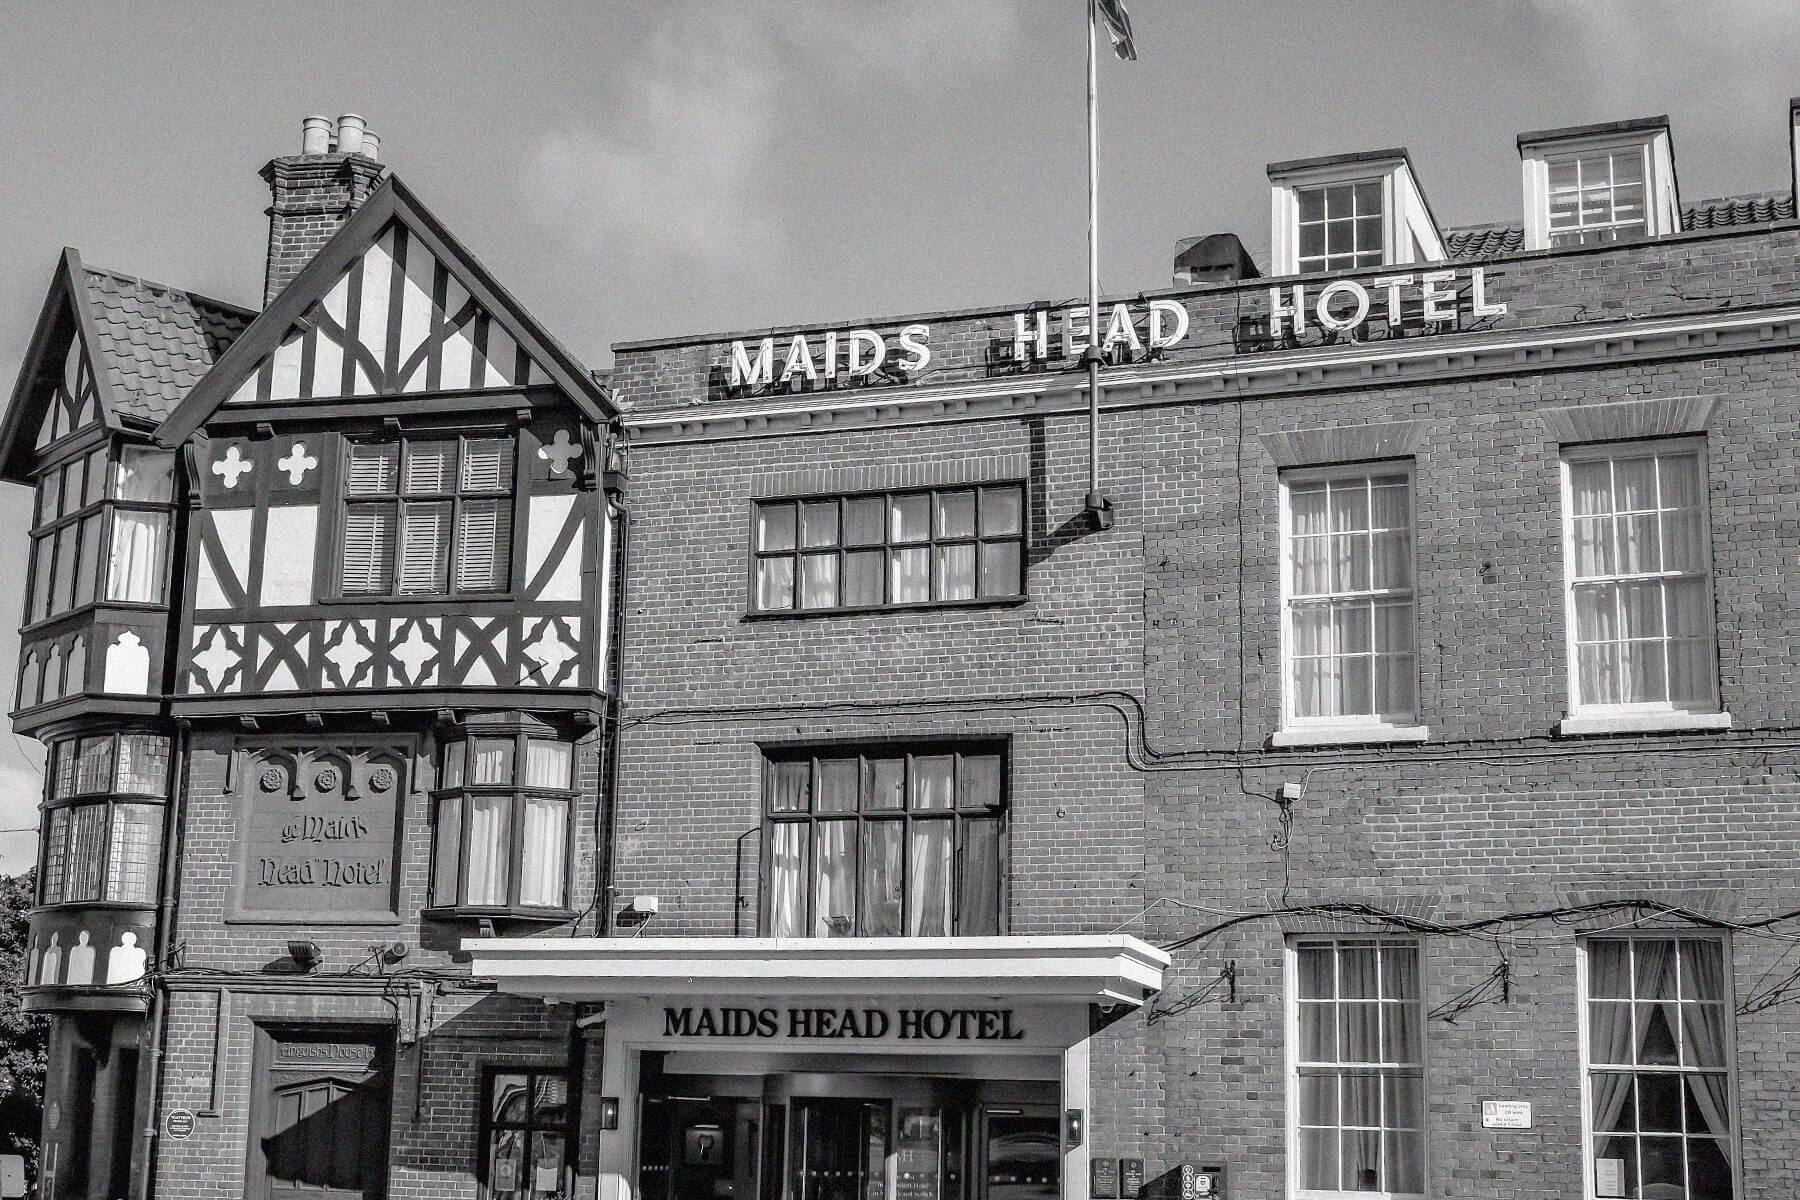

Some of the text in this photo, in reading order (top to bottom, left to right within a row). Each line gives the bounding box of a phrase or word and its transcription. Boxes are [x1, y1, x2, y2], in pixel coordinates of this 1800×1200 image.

[731, 267, 1508, 386] MAIDS HEAD HOTEL
[663, 1007, 1024, 1040] MAIDS HEAD HOTEL
